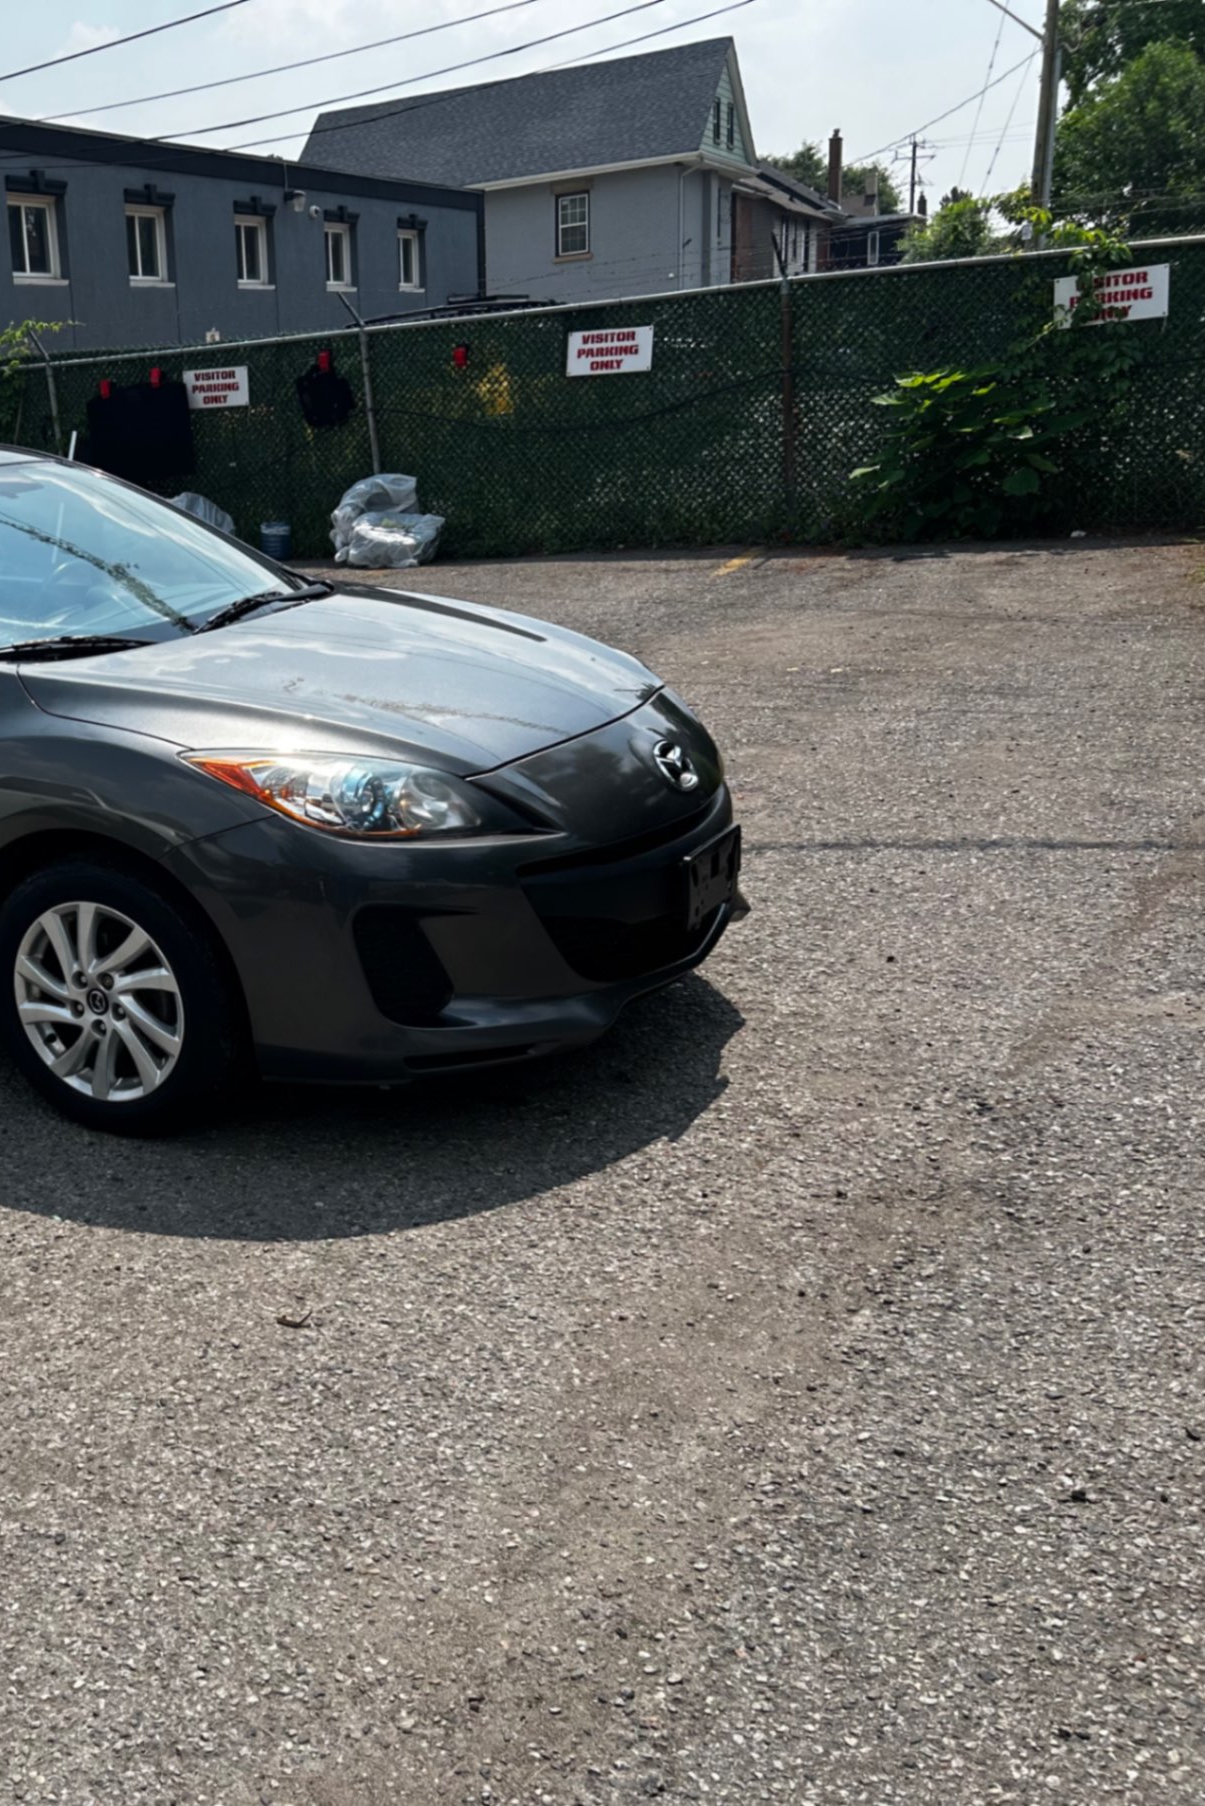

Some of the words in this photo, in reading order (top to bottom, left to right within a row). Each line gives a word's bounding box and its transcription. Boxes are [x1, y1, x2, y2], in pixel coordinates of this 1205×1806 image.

[1077, 271, 1148, 291] SITOR
[1069, 286, 1153, 309] PRKING
[582, 330, 636, 345] VISITOR
[577, 344, 639, 359] PARKING
[590, 359, 624, 371] ONLY
[194, 370, 236, 382] VISITOR
[192, 381, 240, 394] PARKING
[203, 394, 228, 405] ONLY
